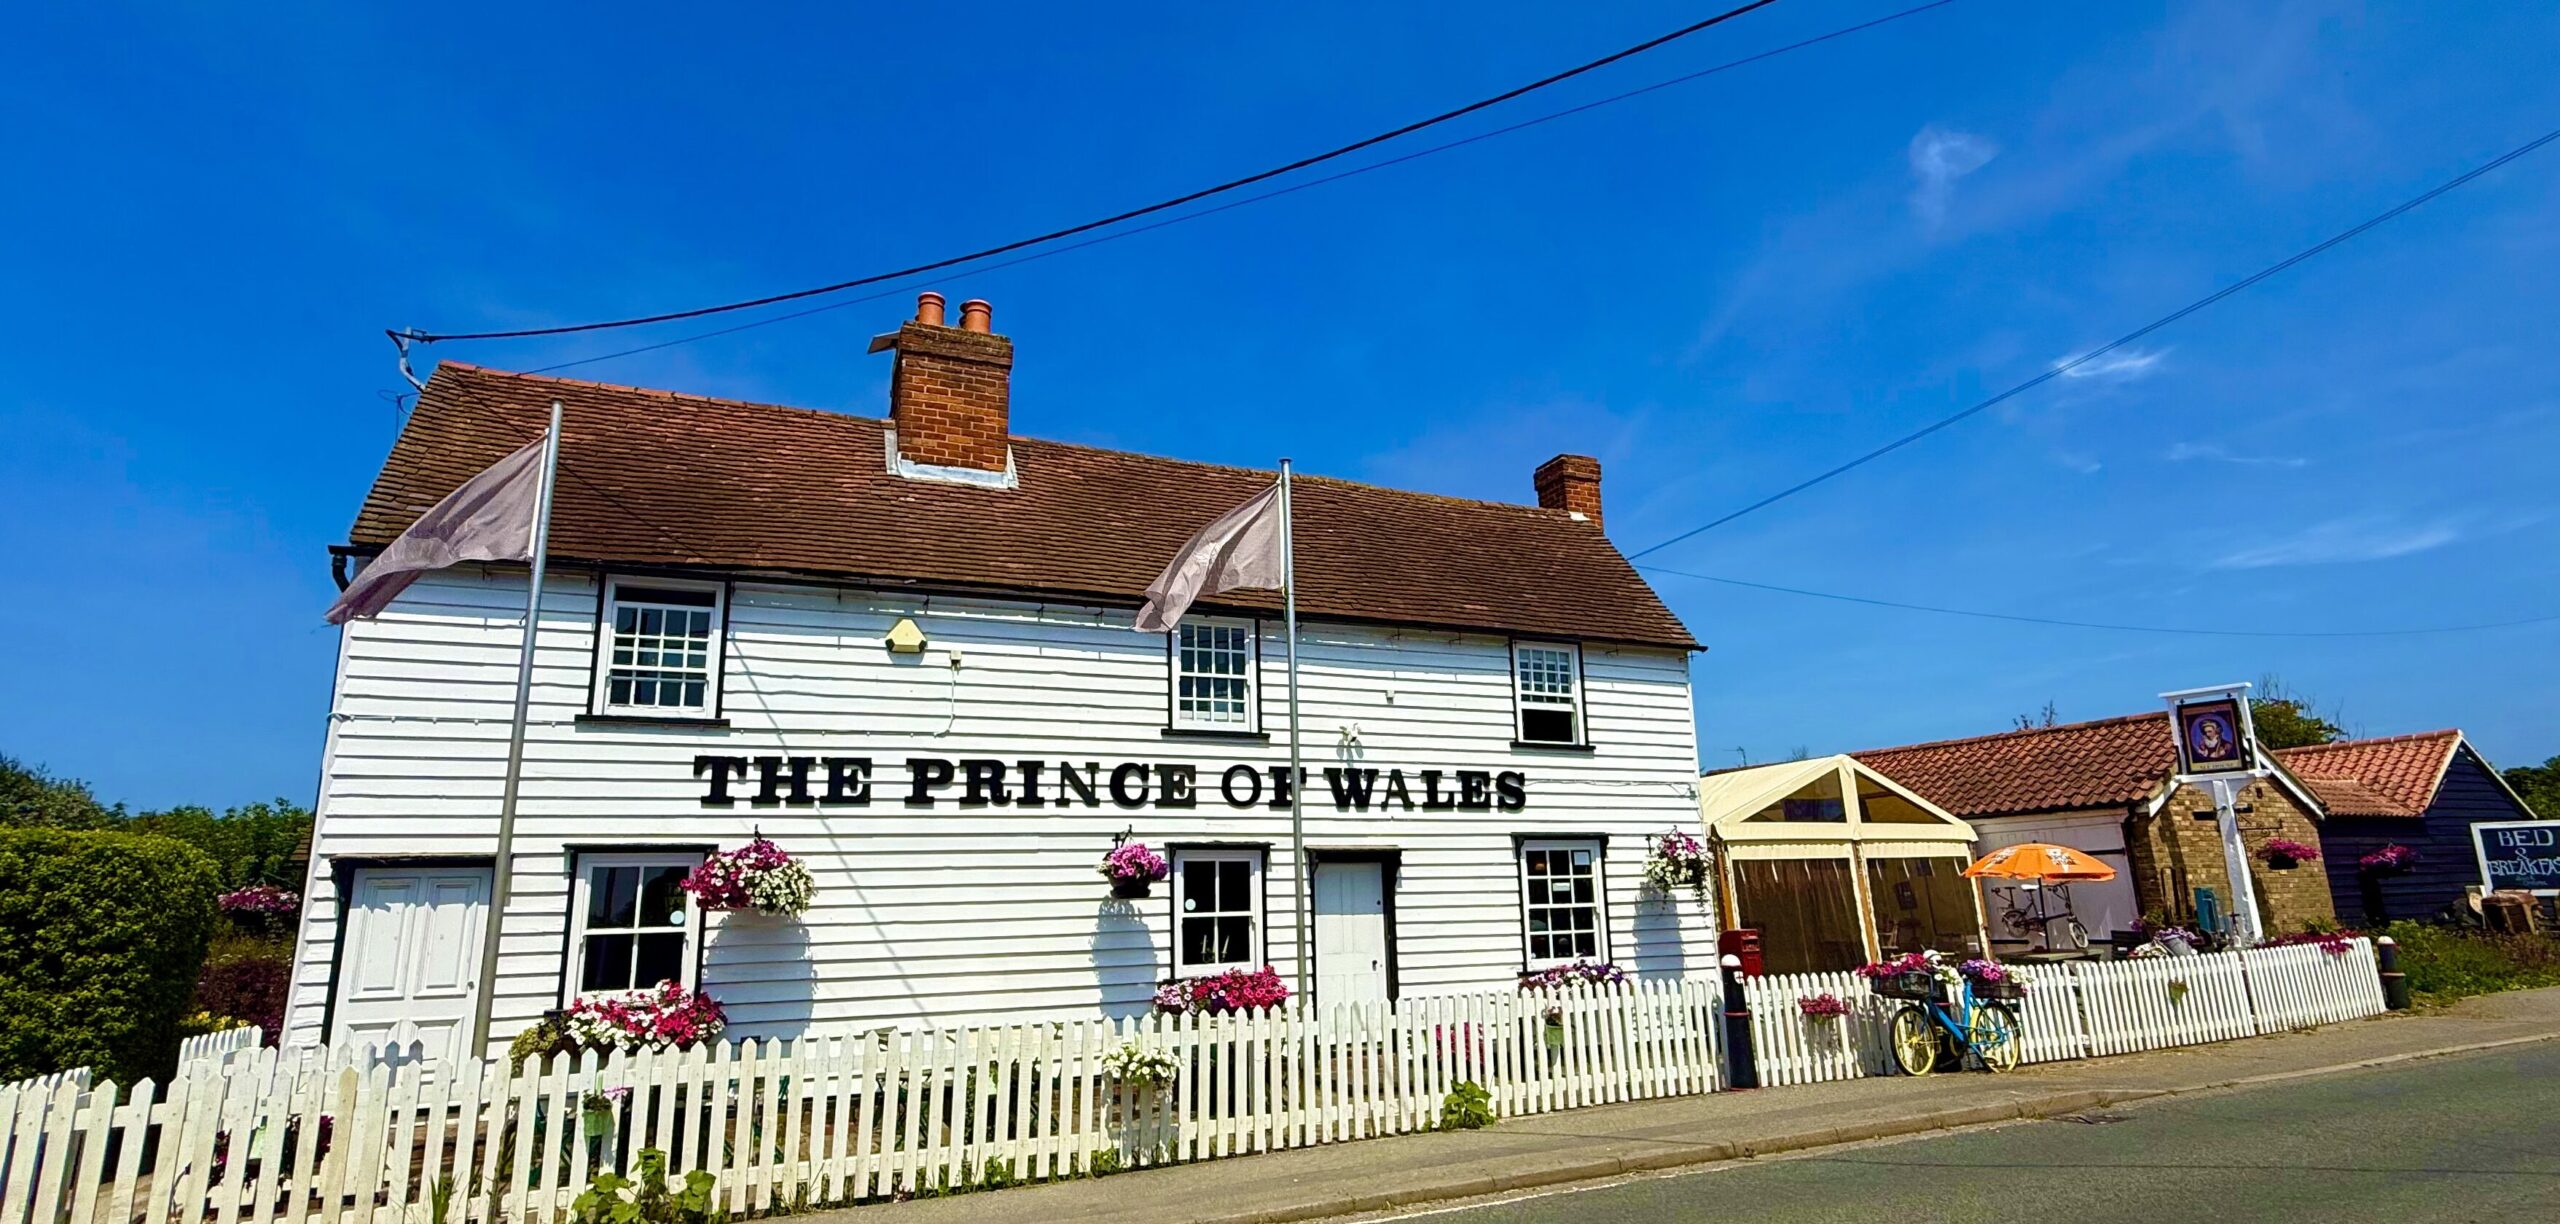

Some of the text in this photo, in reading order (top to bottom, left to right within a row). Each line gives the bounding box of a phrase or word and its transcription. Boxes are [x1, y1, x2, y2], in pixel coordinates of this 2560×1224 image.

[693, 755, 1527, 812] THE PRINCE OF WALES
[2497, 829, 2554, 847] BED
[2486, 856, 2560, 876] BREAKFAS
